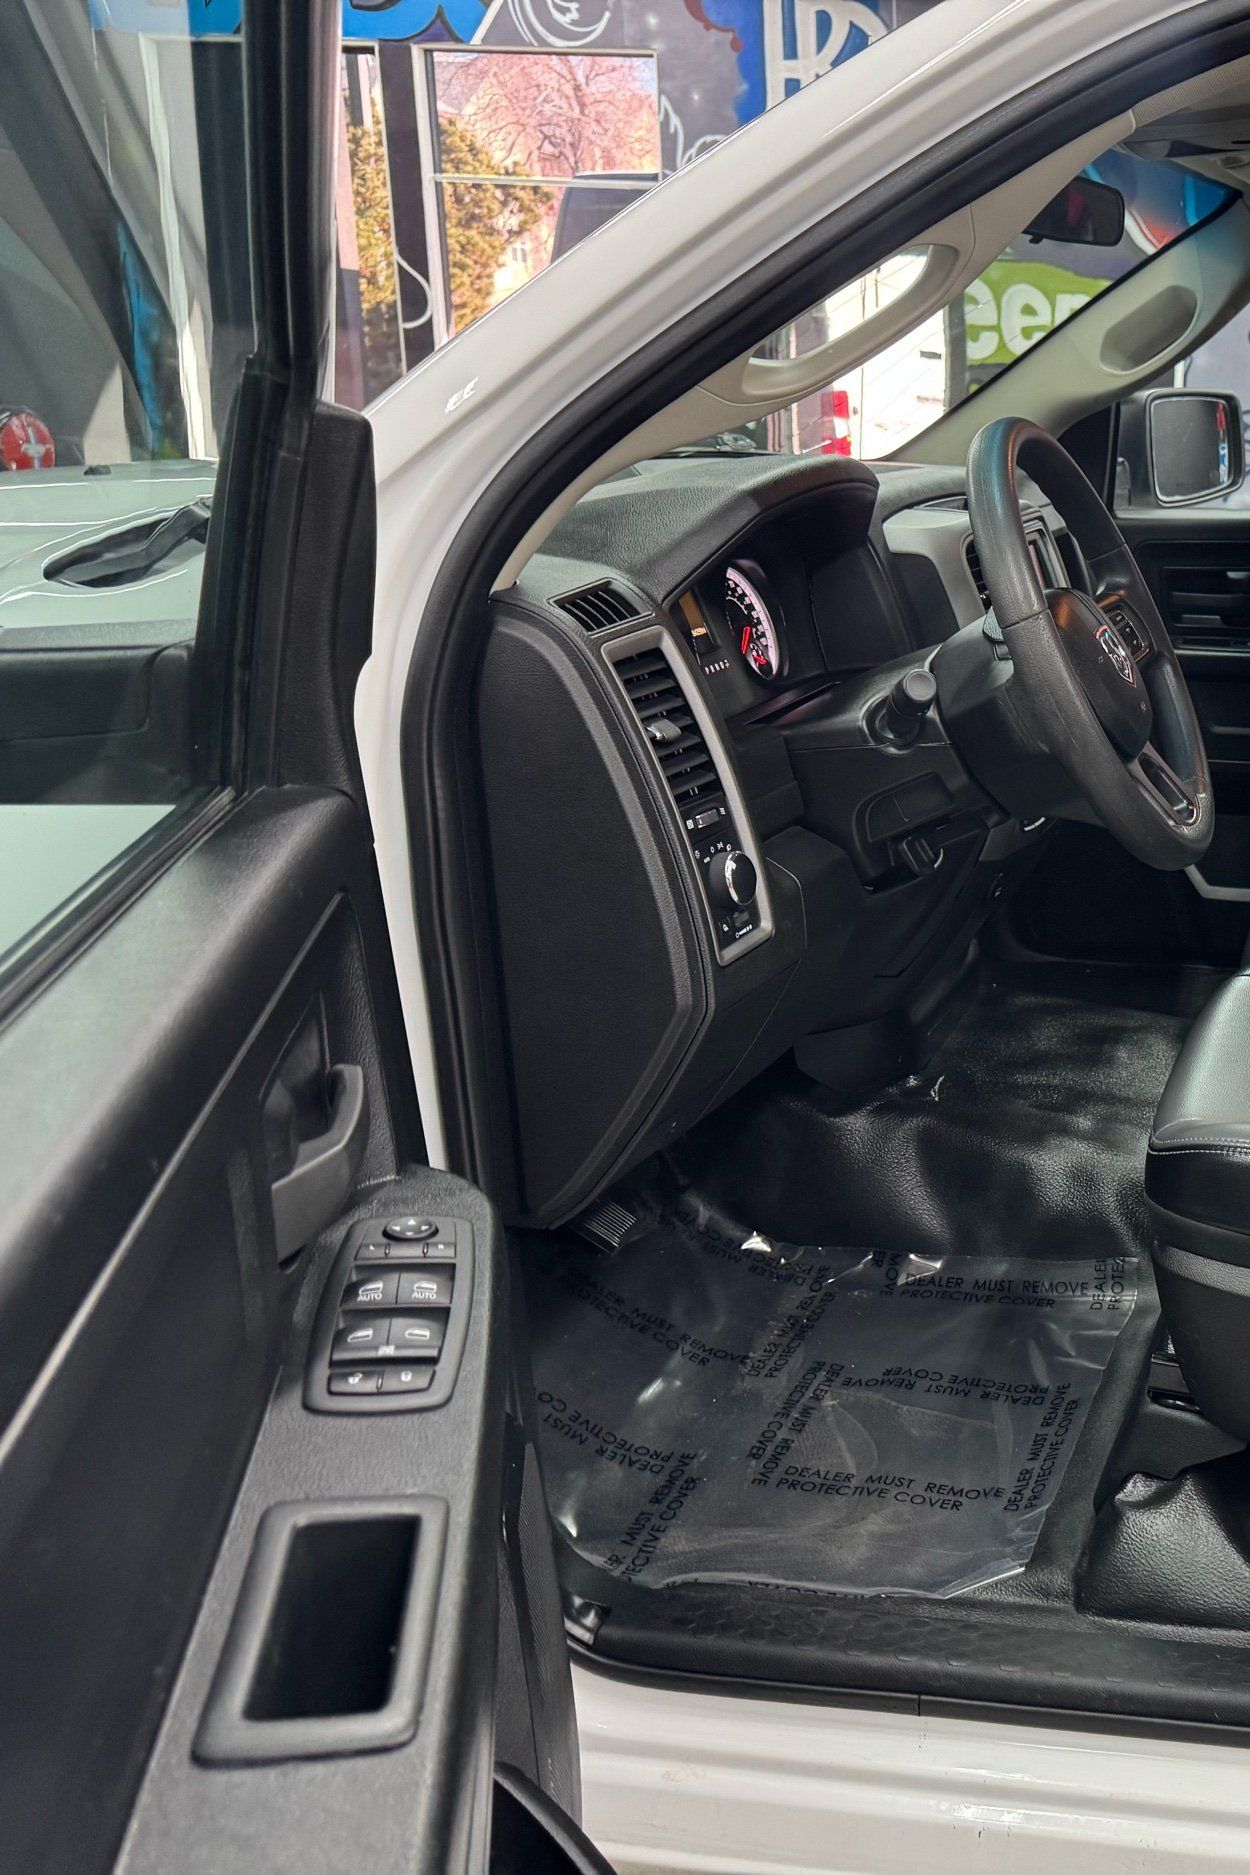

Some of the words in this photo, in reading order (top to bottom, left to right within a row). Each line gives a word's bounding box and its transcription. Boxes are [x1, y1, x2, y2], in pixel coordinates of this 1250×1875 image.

[357, 1292, 382, 1302] AUTO
[412, 1291, 437, 1300] AUTO
[905, 1273, 964, 1289] DEALER
[972, 1278, 1015, 1293] MUST
[1022, 1279, 1089, 1296] REMOVE
[901, 1288, 995, 1305] PROTECTIVE
[997, 1297, 1056, 1310] COVER
[631, 1307, 676, 1332] MUST
[652, 1331, 711, 1367] COVER
[841, 1376, 917, 1391] REMOVE
[882, 1366, 945, 1382] COVER
[950, 1374, 1050, 1395] PROTECTIVE
[537, 1391, 568, 1413] CO
[924, 1382, 971, 1398] MUST
[980, 1390, 1046, 1408] DEALER
[543, 1413, 589, 1446] MUST
[568, 1410, 674, 1463] PROTECTIVE
[745, 1420, 784, 1460] COVER
[595, 1445, 665, 1475] DEALER
[1003, 1468, 1034, 1513] DEALER
[1026, 1432, 1049, 1462] MUST
[1041, 1382, 1071, 1427] REMOVE
[784, 1465, 855, 1483] DEALER
[865, 1473, 916, 1489] MUST
[924, 1482, 1007, 1501] REMOVE
[1024, 1438, 1064, 1510] PROTECTIVE
[620, 1511, 654, 1546] MUST
[650, 1452, 698, 1504] REMOVE
[660, 1475, 698, 1521] COVER
[776, 1477, 890, 1499] PROTECTIVE
[893, 1491, 964, 1512] COVER
